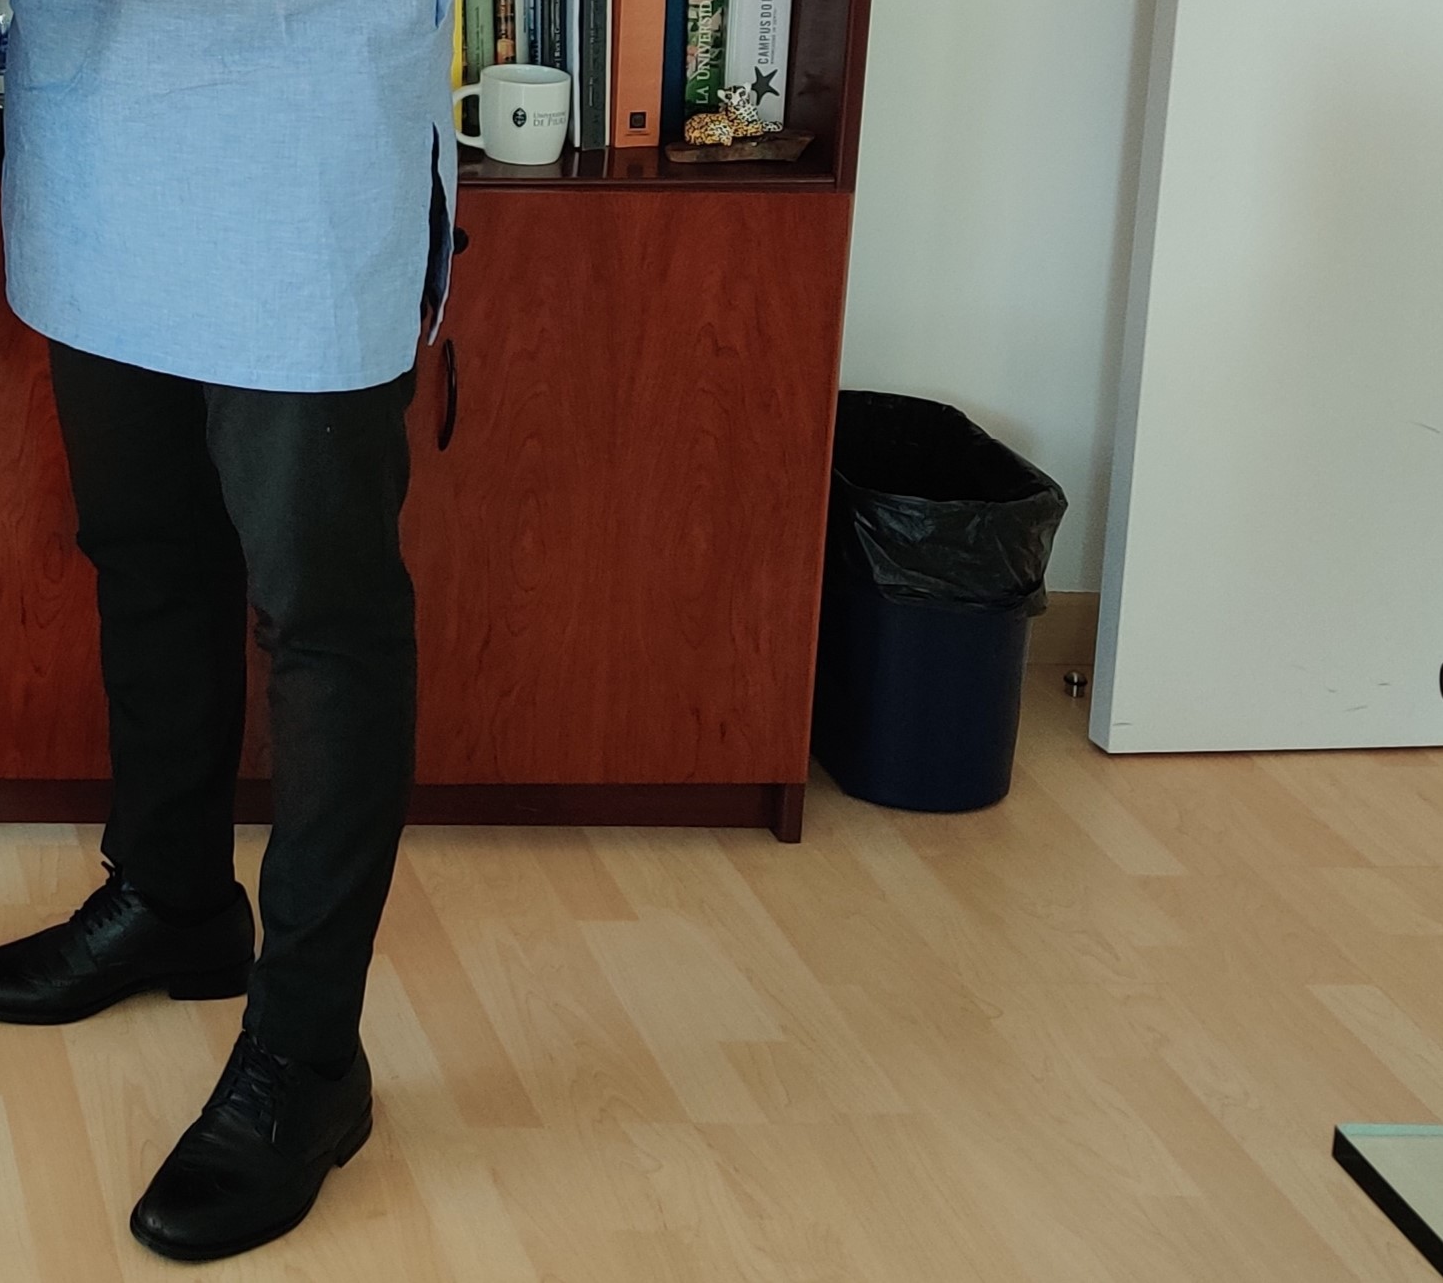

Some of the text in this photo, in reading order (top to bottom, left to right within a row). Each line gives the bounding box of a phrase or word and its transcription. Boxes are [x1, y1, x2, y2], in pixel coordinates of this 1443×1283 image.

[759, 3, 773, 18] DO
[757, 20, 772, 65] CAMPUS
[695, 86, 710, 105] LA
